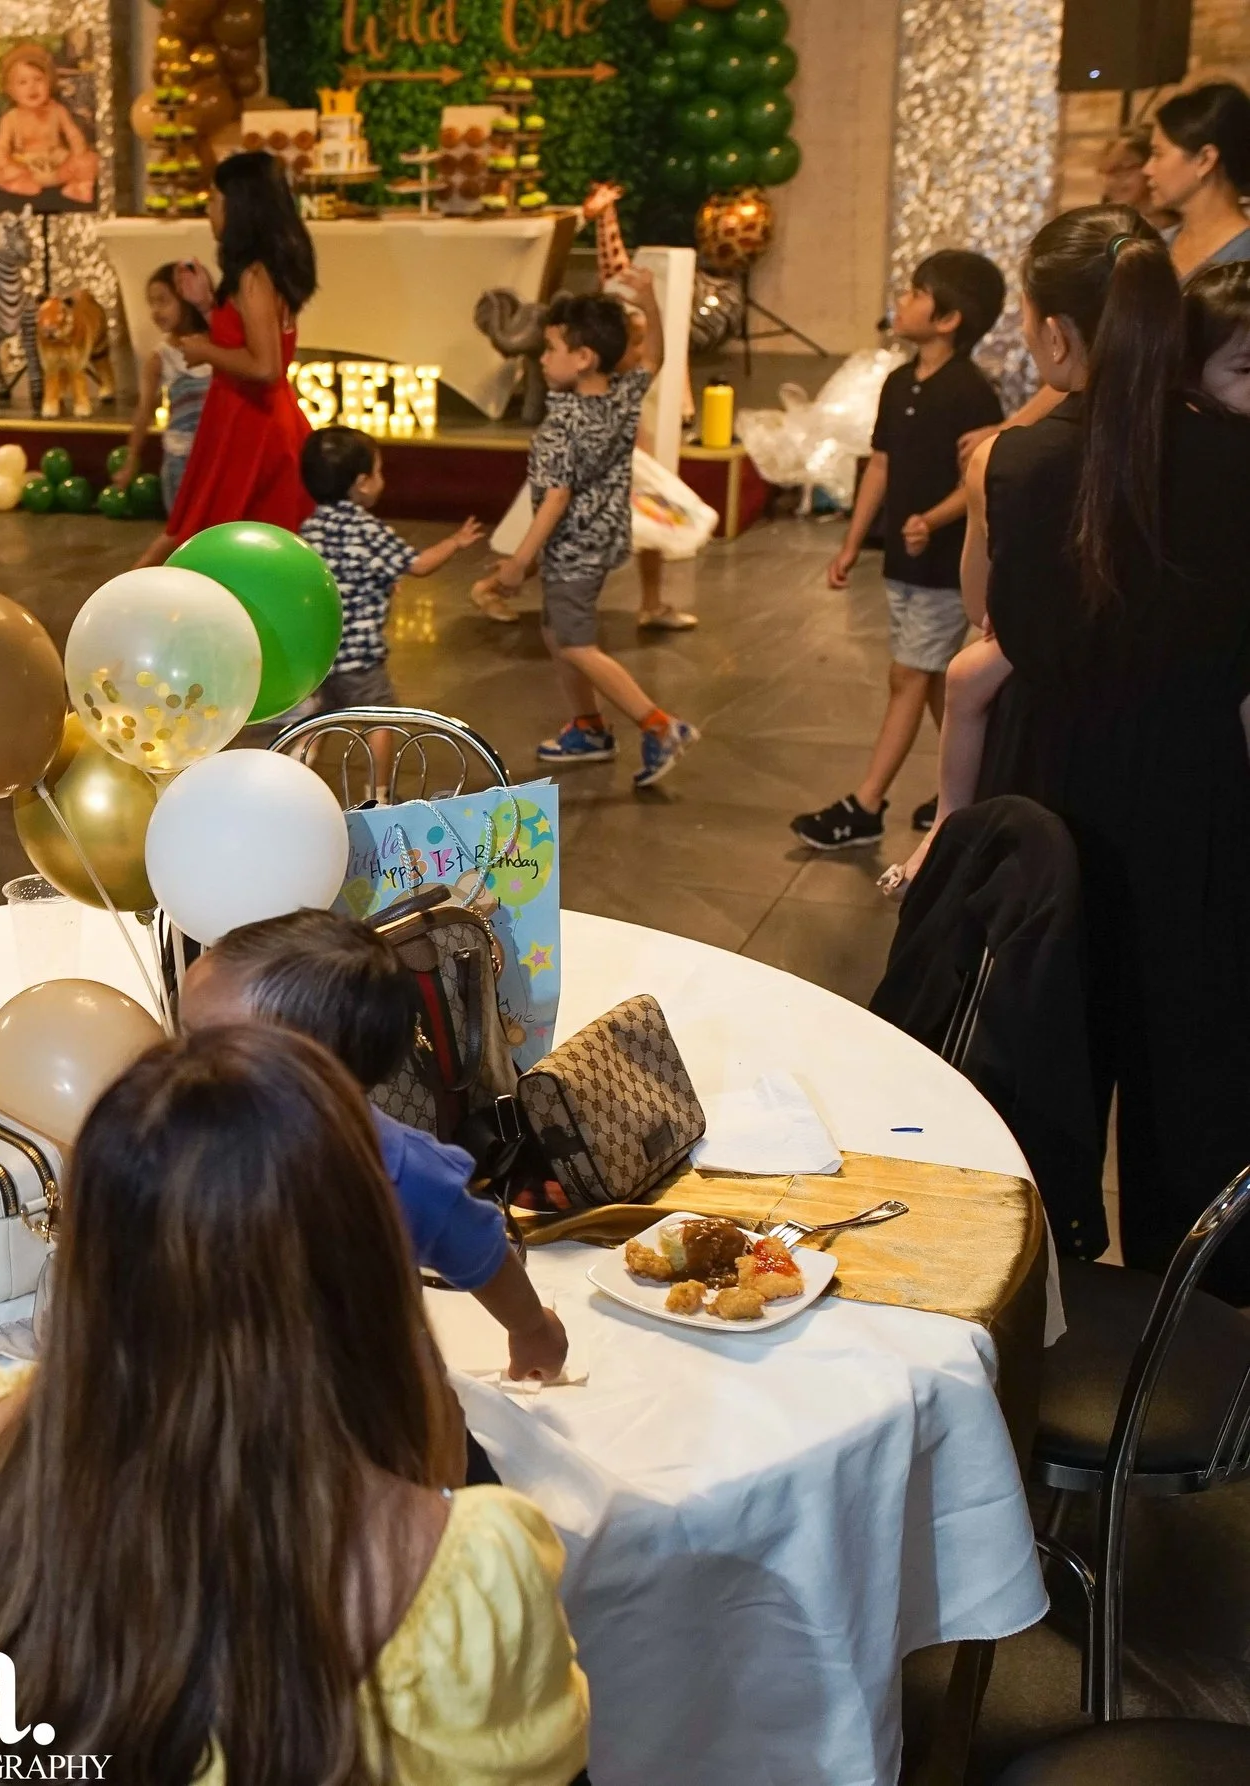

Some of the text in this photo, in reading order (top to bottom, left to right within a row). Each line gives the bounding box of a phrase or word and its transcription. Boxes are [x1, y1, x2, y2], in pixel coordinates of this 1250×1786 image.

[295, 193, 337, 219] NE
[287, 360, 443, 433] SEN
[370, 857, 424, 889] Happy
